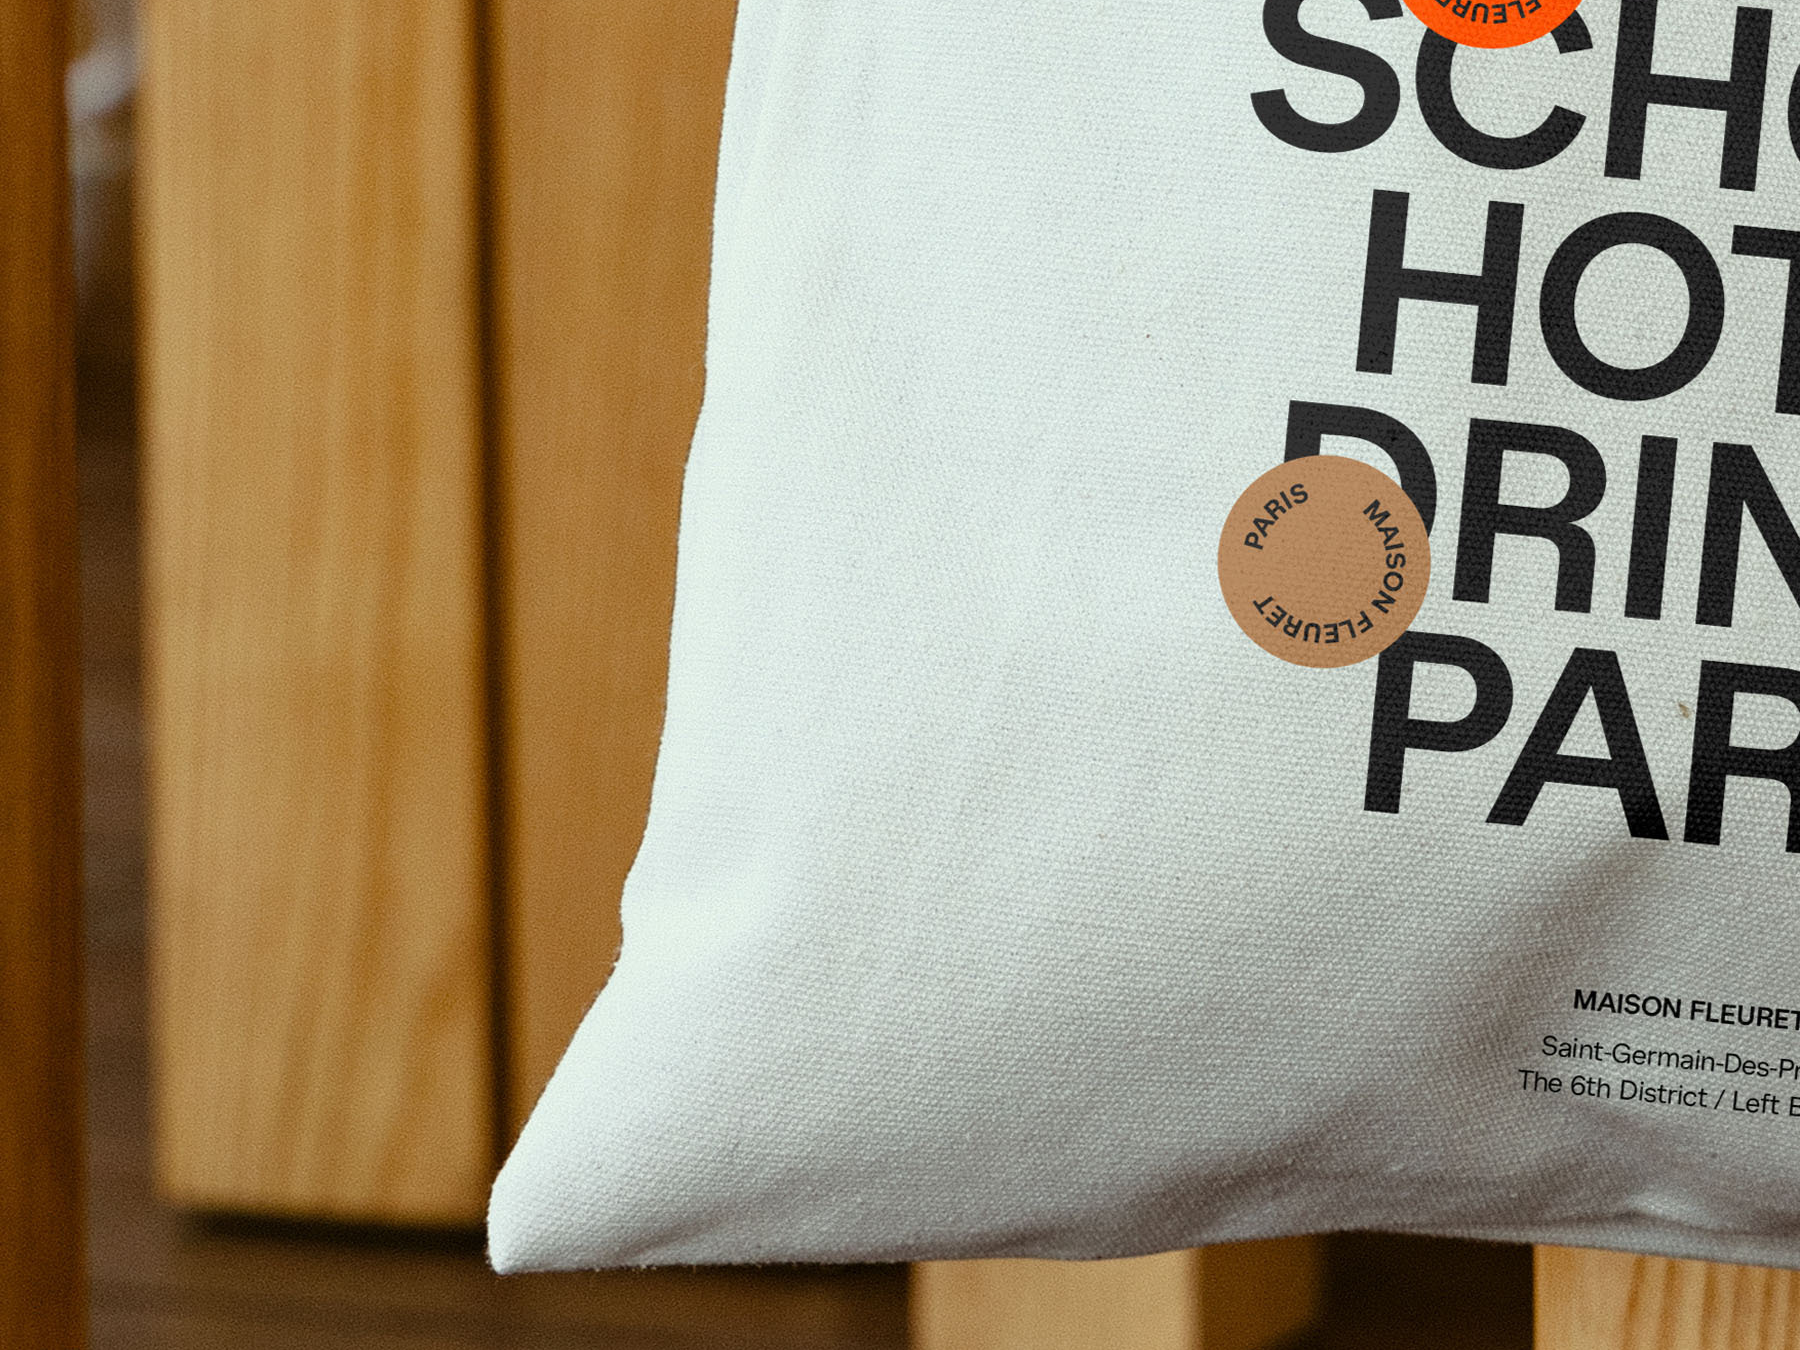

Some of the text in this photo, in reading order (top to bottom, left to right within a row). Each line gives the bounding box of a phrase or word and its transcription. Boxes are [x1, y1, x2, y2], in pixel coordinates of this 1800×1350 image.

[1244, 483, 1309, 550] PARIS
[1252, 499, 1407, 644] MAISON FLEURET
[1573, 988, 1682, 1020] MAISON
[1518, 1069, 1563, 1093] The
[1570, 1075, 1611, 1099] 6th
[1619, 1079, 1708, 1109] District
[1713, 1089, 1726, 1111] /
[1732, 1090, 1780, 1116] Left
